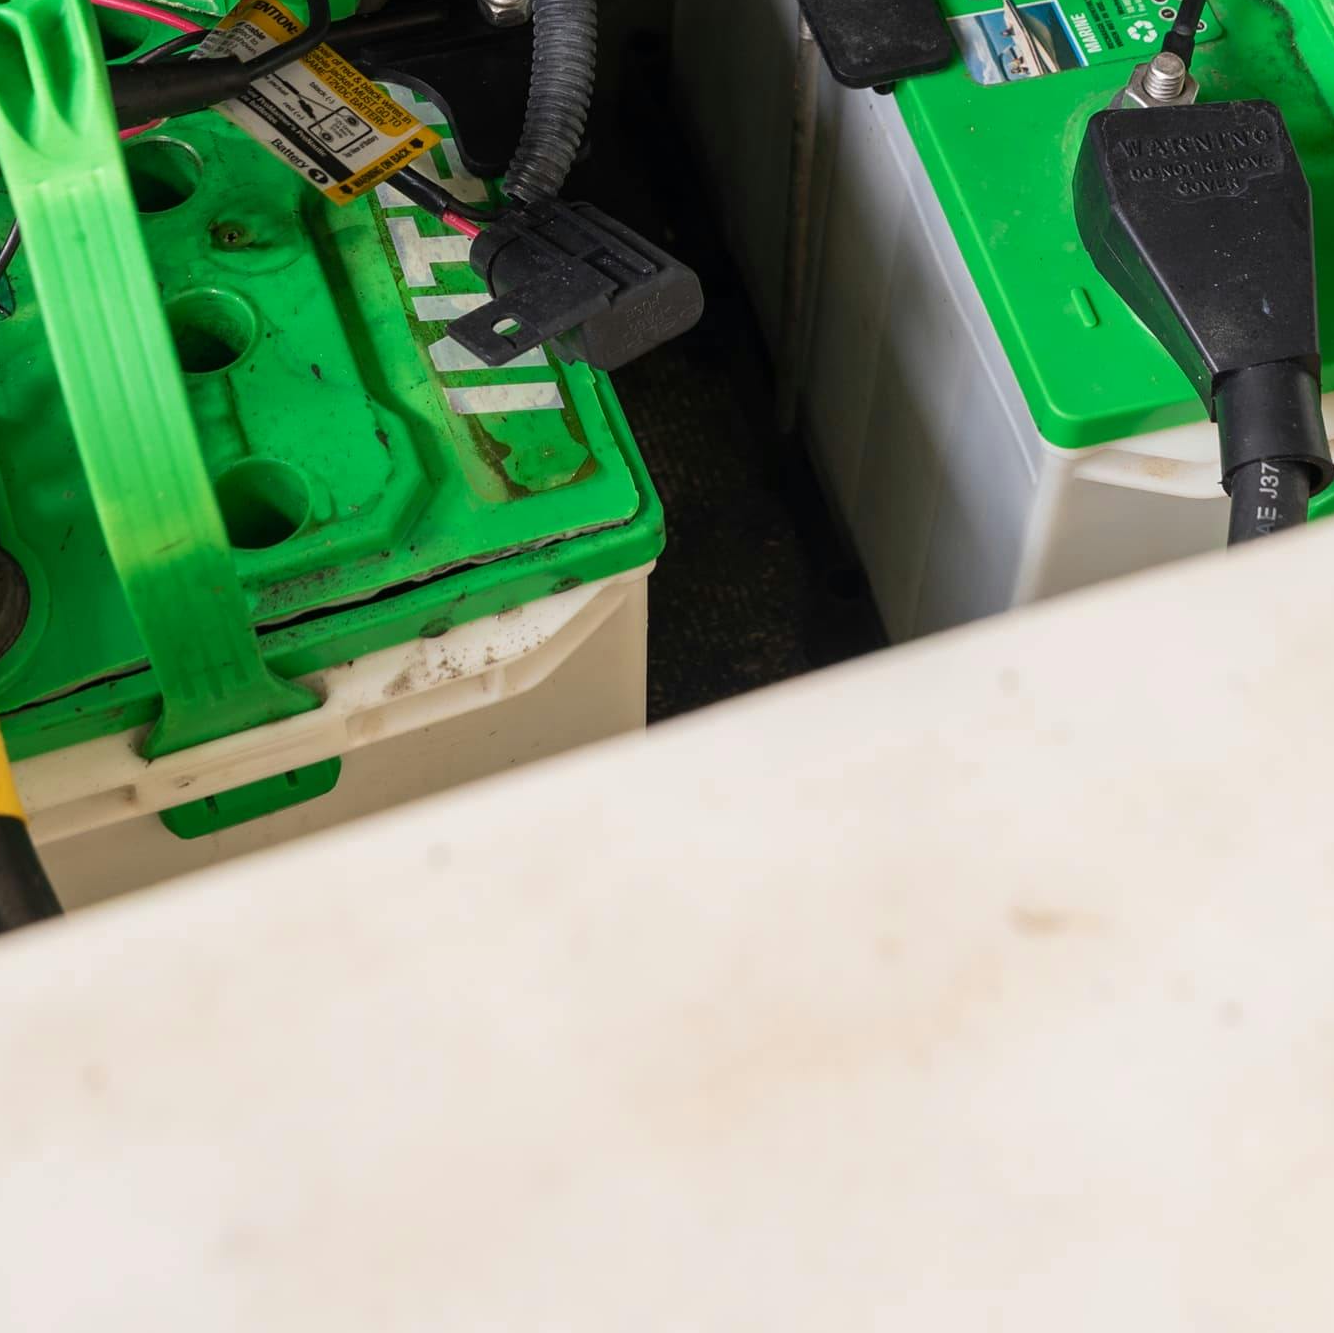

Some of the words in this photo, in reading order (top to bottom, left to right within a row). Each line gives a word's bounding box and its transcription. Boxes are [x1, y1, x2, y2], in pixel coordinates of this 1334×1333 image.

[1071, 14, 1100, 52] MARINE
[308, 81, 327, 97] black
[324, 74, 352, 98] 12VDC
[349, 96, 387, 126] BATTERY
[330, 57, 342, 66] of
[339, 64, 355, 78] red
[359, 81, 382, 101] black
[380, 98, 403, 118] wires
[351, 86, 378, 106] MUST
[374, 105, 390, 118] GO
[387, 114, 402, 127] TO
[270, 138, 308, 168] Battery
[389, 146, 414, 164] BACK
[1117, 128, 1270, 159] WARNING
